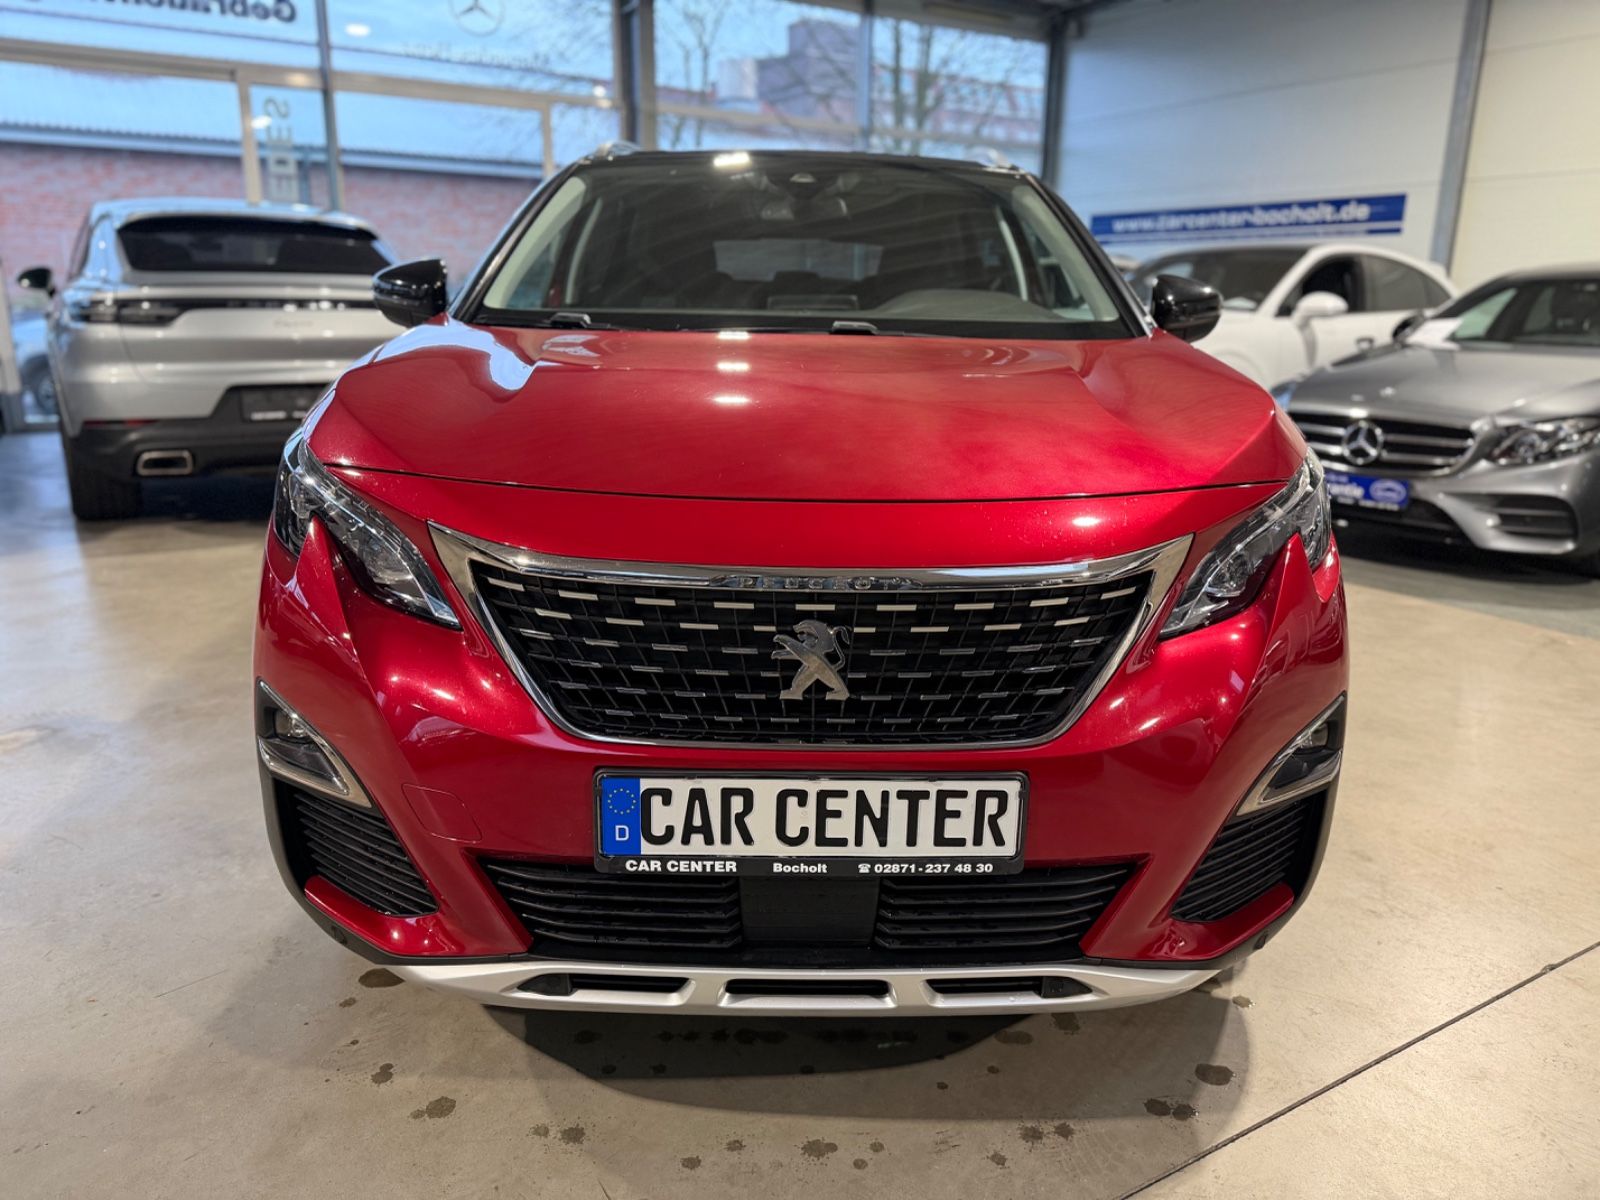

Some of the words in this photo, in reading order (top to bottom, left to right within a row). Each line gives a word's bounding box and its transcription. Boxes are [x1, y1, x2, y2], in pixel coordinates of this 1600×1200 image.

[640, 787, 755, 846] CAR
[775, 788, 1009, 848] CENTER
[615, 824, 630, 842] D
[625, 859, 662, 872] CAR
[666, 860, 738, 874] CENTER
[772, 862, 828, 874] Bocholt
[954, 863, 972, 874] 48
[975, 863, 994, 874] 30
